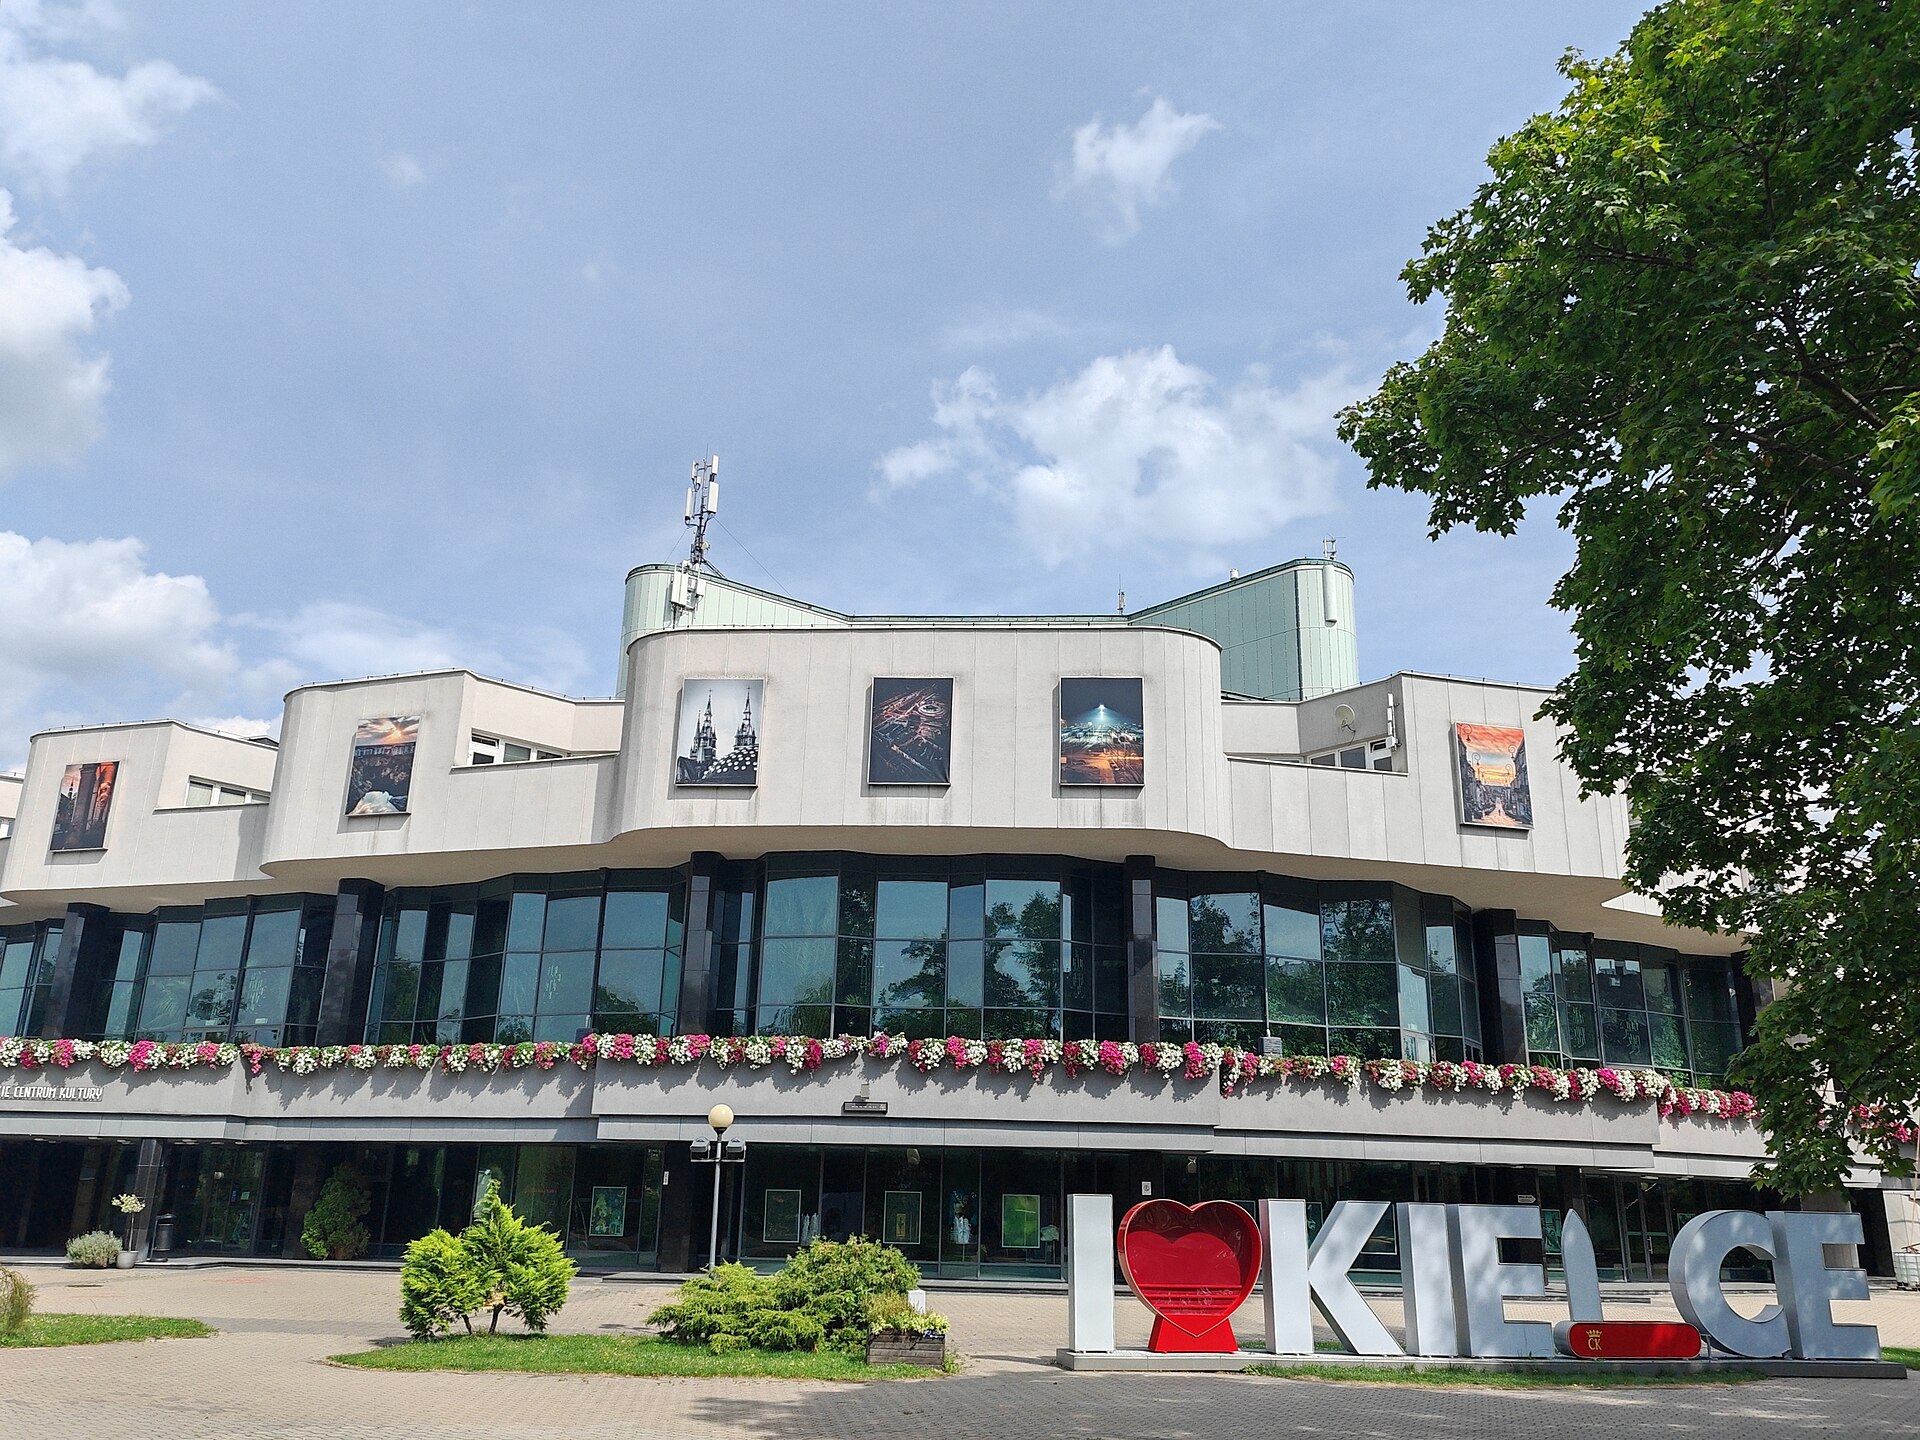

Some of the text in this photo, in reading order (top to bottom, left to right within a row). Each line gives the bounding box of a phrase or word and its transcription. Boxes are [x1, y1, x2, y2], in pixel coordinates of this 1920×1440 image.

[14, 1086, 56, 1098] CENTRUM
[59, 1087, 103, 1099] KULTURY
[1067, 1194, 1880, 1360] I KIELCE
[1587, 1337, 1602, 1351] CK
